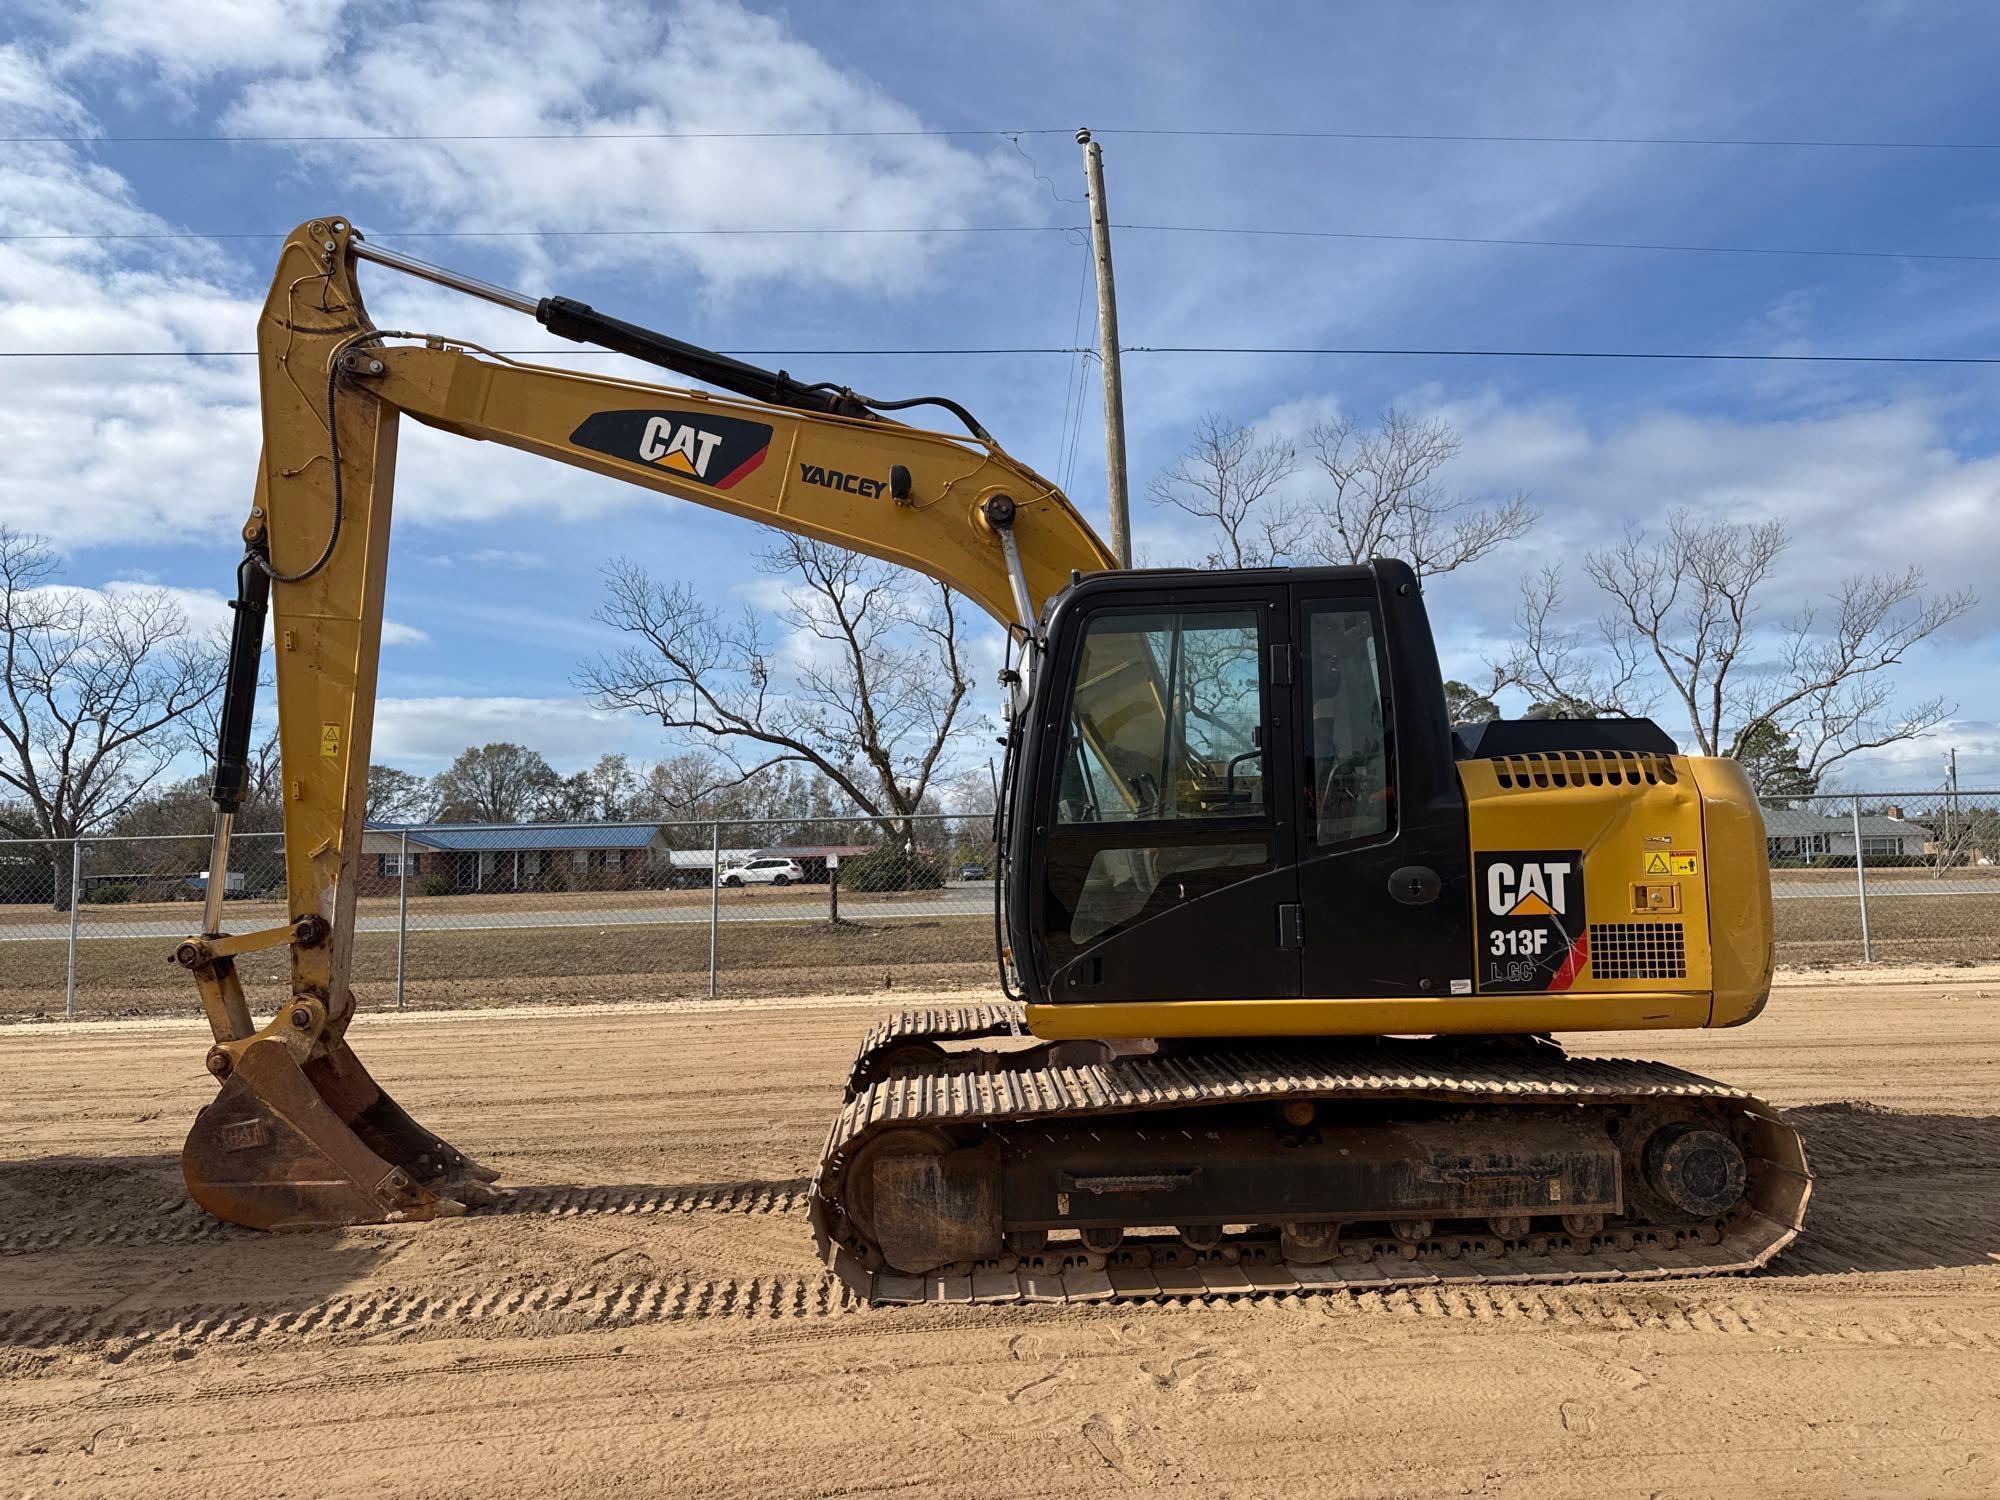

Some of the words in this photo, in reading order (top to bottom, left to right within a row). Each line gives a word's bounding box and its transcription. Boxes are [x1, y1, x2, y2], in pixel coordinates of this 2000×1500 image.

[638, 416, 722, 478] CAT
[800, 463, 887, 499] YANCEY
[1487, 862, 1571, 915] CAT
[1490, 929, 1548, 956] 313F
